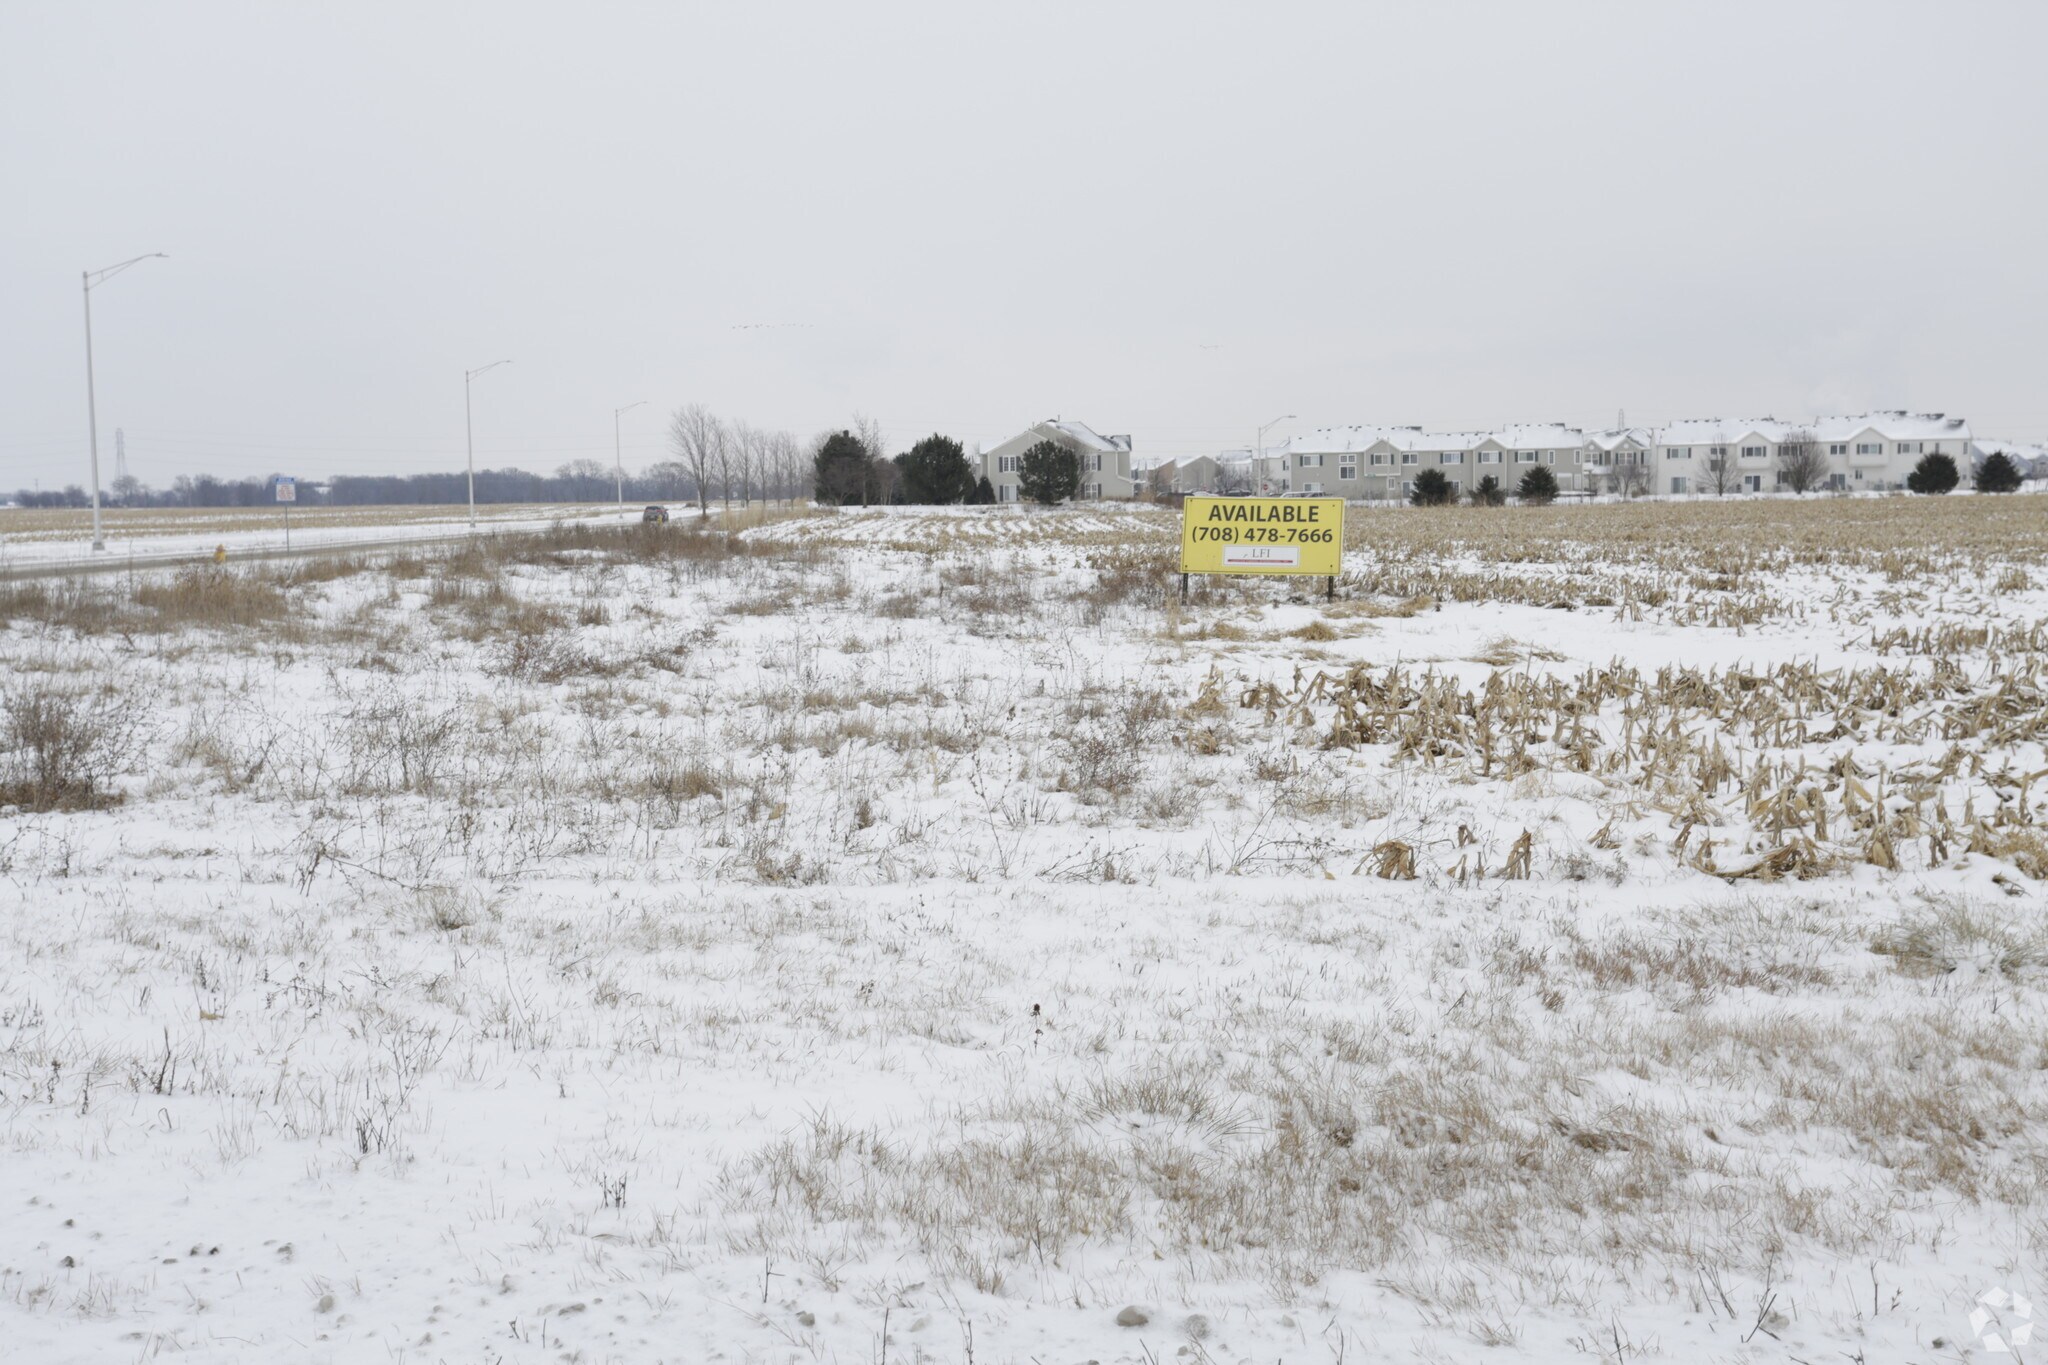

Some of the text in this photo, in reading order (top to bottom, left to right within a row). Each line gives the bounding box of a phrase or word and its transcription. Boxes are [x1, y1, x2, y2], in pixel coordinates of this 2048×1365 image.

[1208, 504, 1319, 522] AVAILABLE
[1192, 526, 1333, 544] (708) 478-7666
